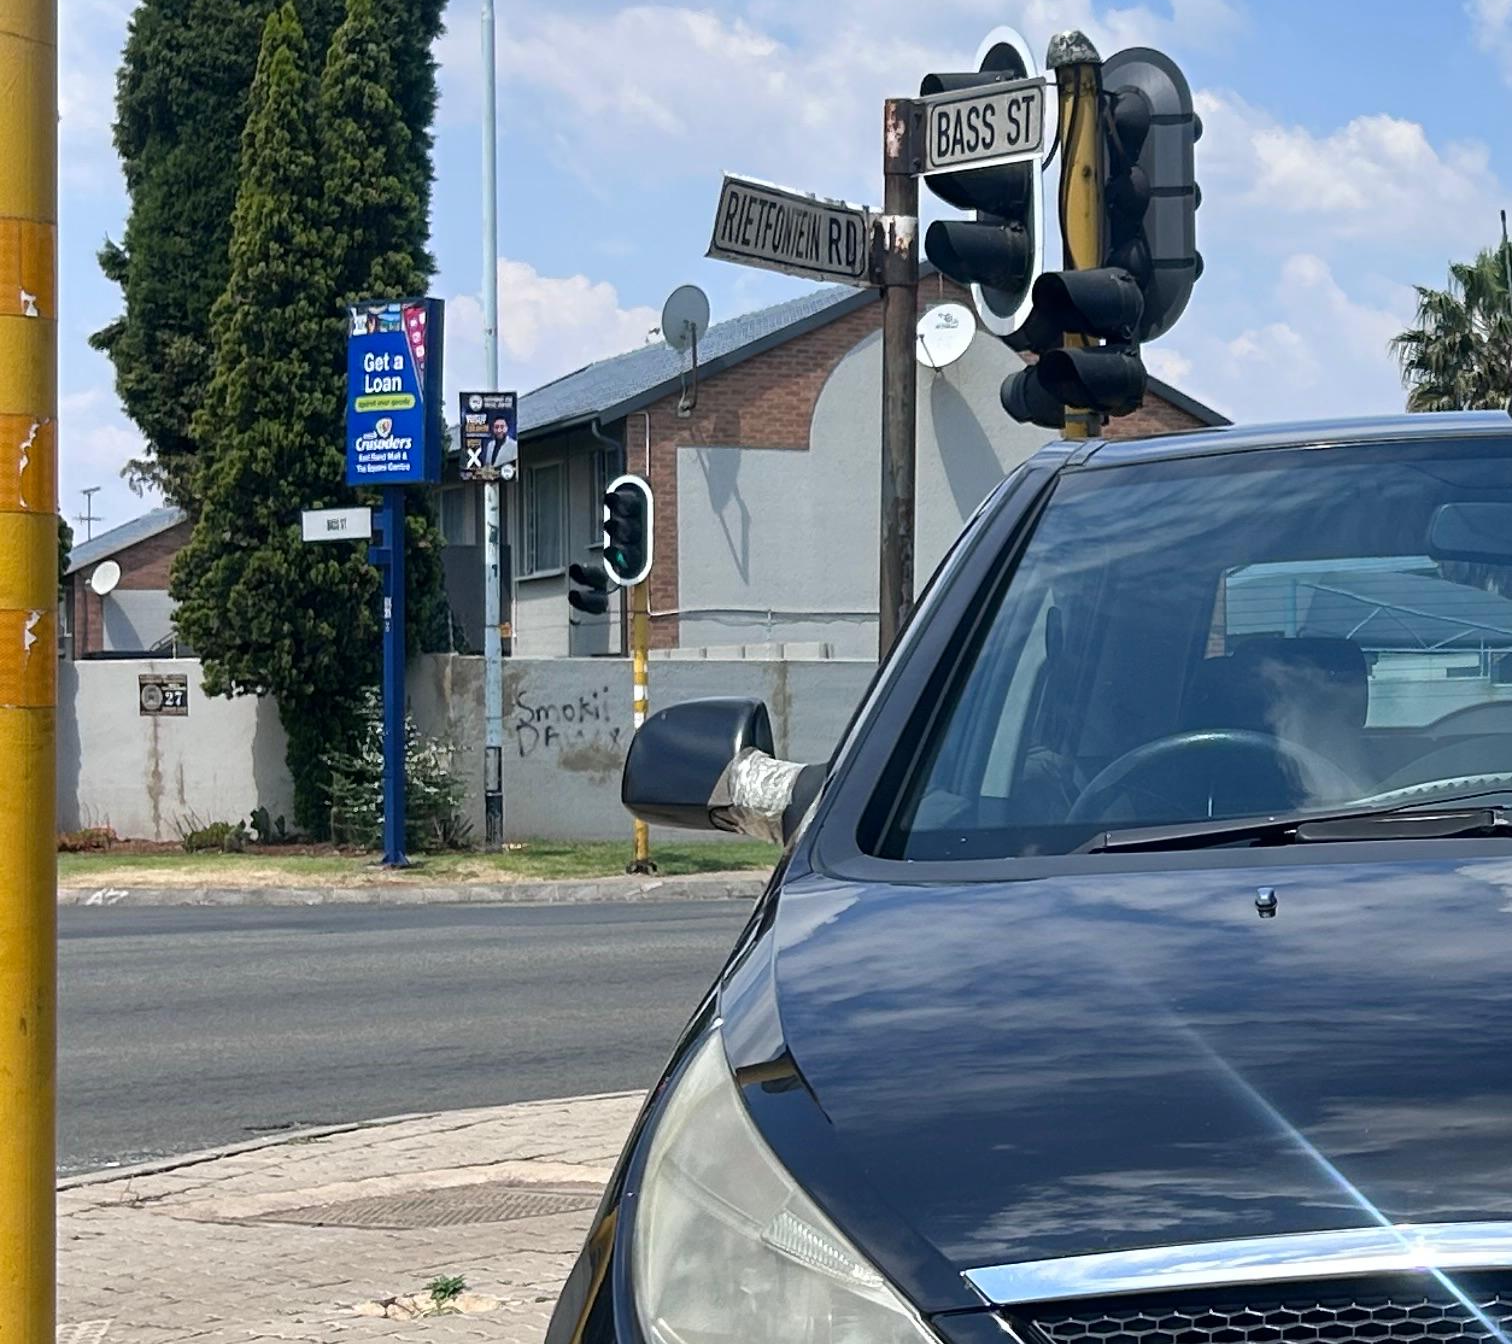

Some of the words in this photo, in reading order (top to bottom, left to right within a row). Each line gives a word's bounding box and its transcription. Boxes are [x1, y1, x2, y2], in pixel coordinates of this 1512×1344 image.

[937, 104, 995, 158] BASS
[1007, 96, 1035, 146] ST
[721, 191, 820, 262] RIETFONTEIN
[829, 218, 857, 266] RD
[364, 352, 390, 372] Get
[393, 355, 404, 371] a
[365, 374, 402, 393] Loan
[355, 434, 412, 452] Crusaders
[165, 691, 183, 706] 27
